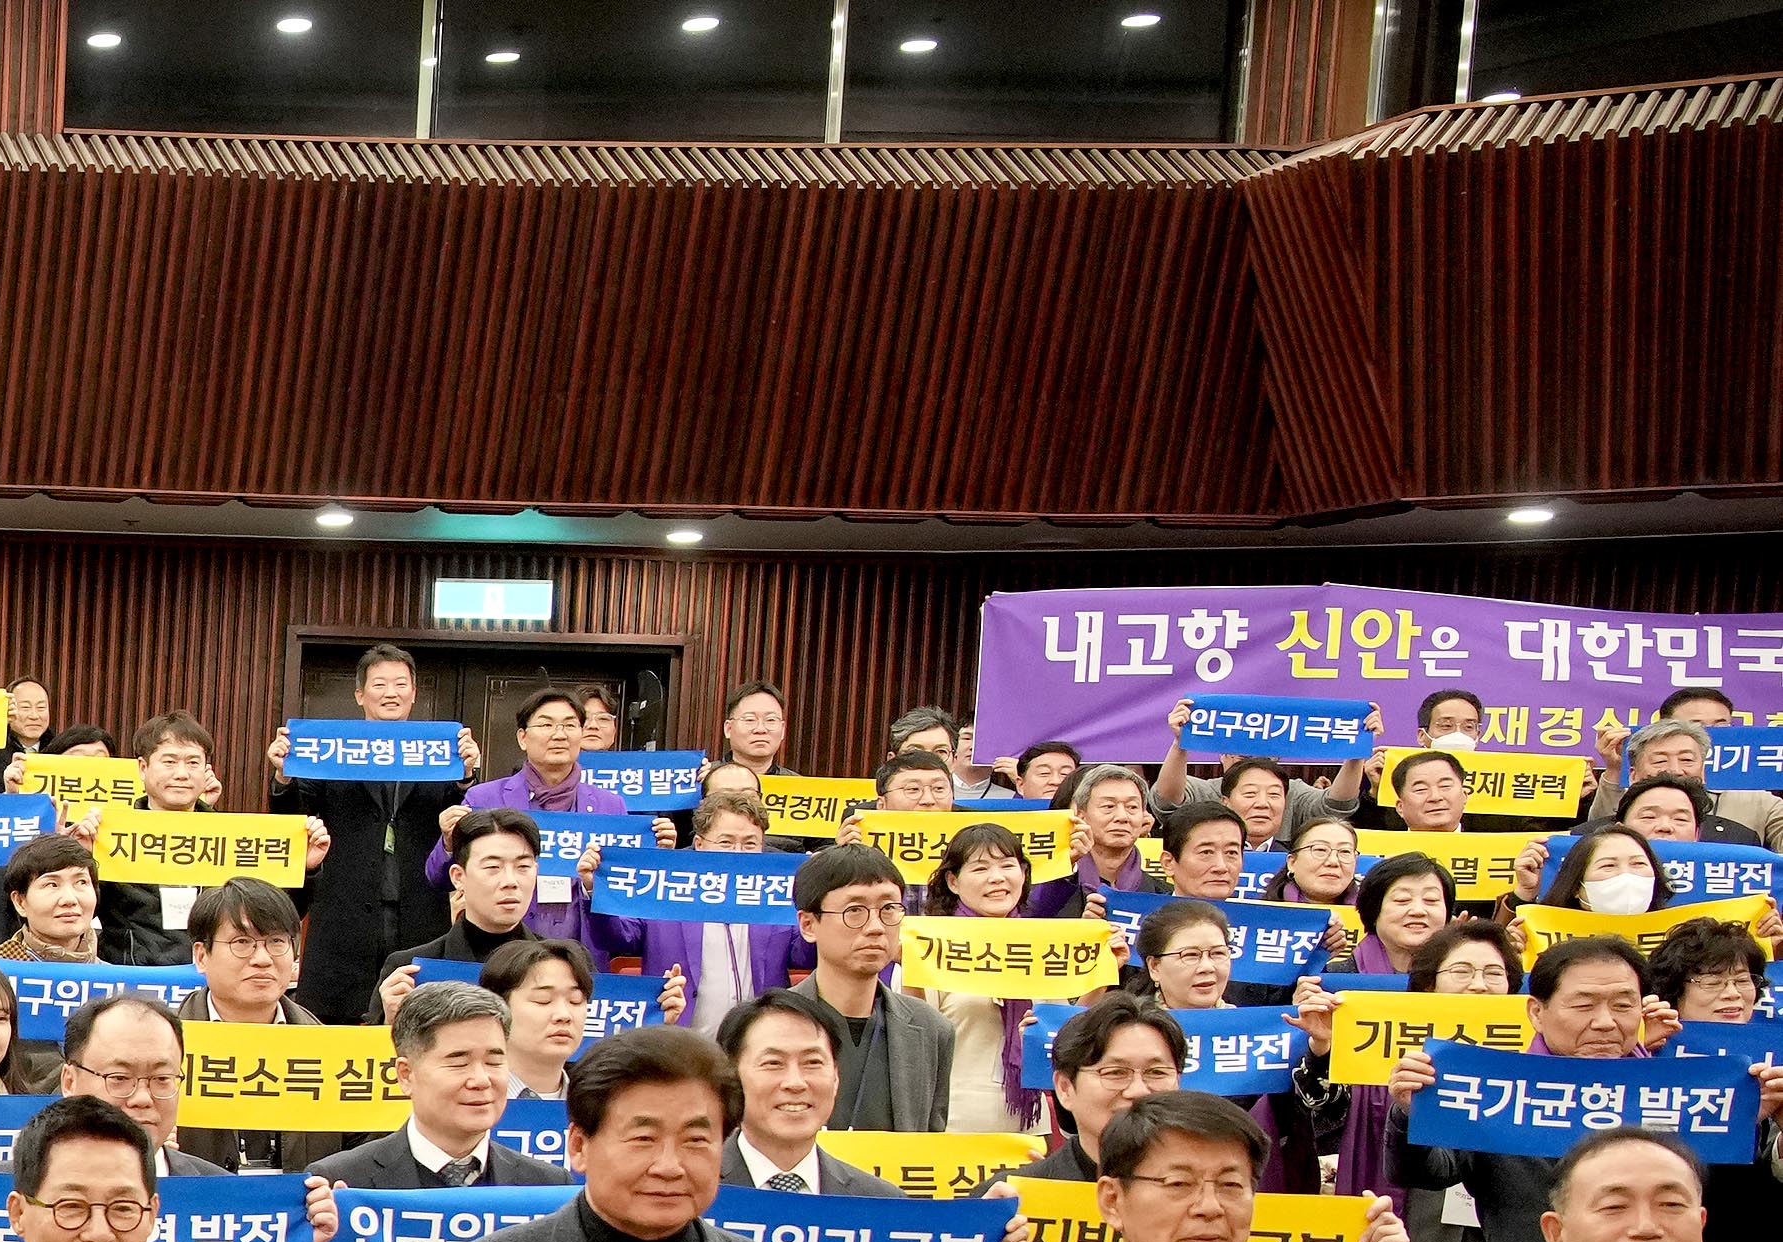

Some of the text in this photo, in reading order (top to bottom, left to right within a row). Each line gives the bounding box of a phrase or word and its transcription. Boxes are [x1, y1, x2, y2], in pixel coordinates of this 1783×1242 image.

[1043, 609, 1249, 683] 내고향
[1276, 607, 1469, 680] 신안은
[1190, 708, 1359, 743] 인구위기 극복
[295, 737, 450, 766] 국가균형 발전
[35, 775, 134, 806] 기본소득
[650, 768, 698, 795] 발전
[1511, 773, 1567, 799] 활력
[763, 793, 838, 822] 역경제
[109, 833, 290, 866] 지역경제 활력
[867, 831, 948, 862] 지방소
[607, 866, 794, 905] 국가균형 발전
[1705, 863, 1772, 894] 발전
[916, 934, 1101, 975] 기본소득 실현
[1256, 929, 1329, 965] 발전
[582, 998, 646, 1037] 발전
[1211, 1031, 1291, 1071] 발전
[1437, 1073, 1735, 1134] 국가균형 발전
